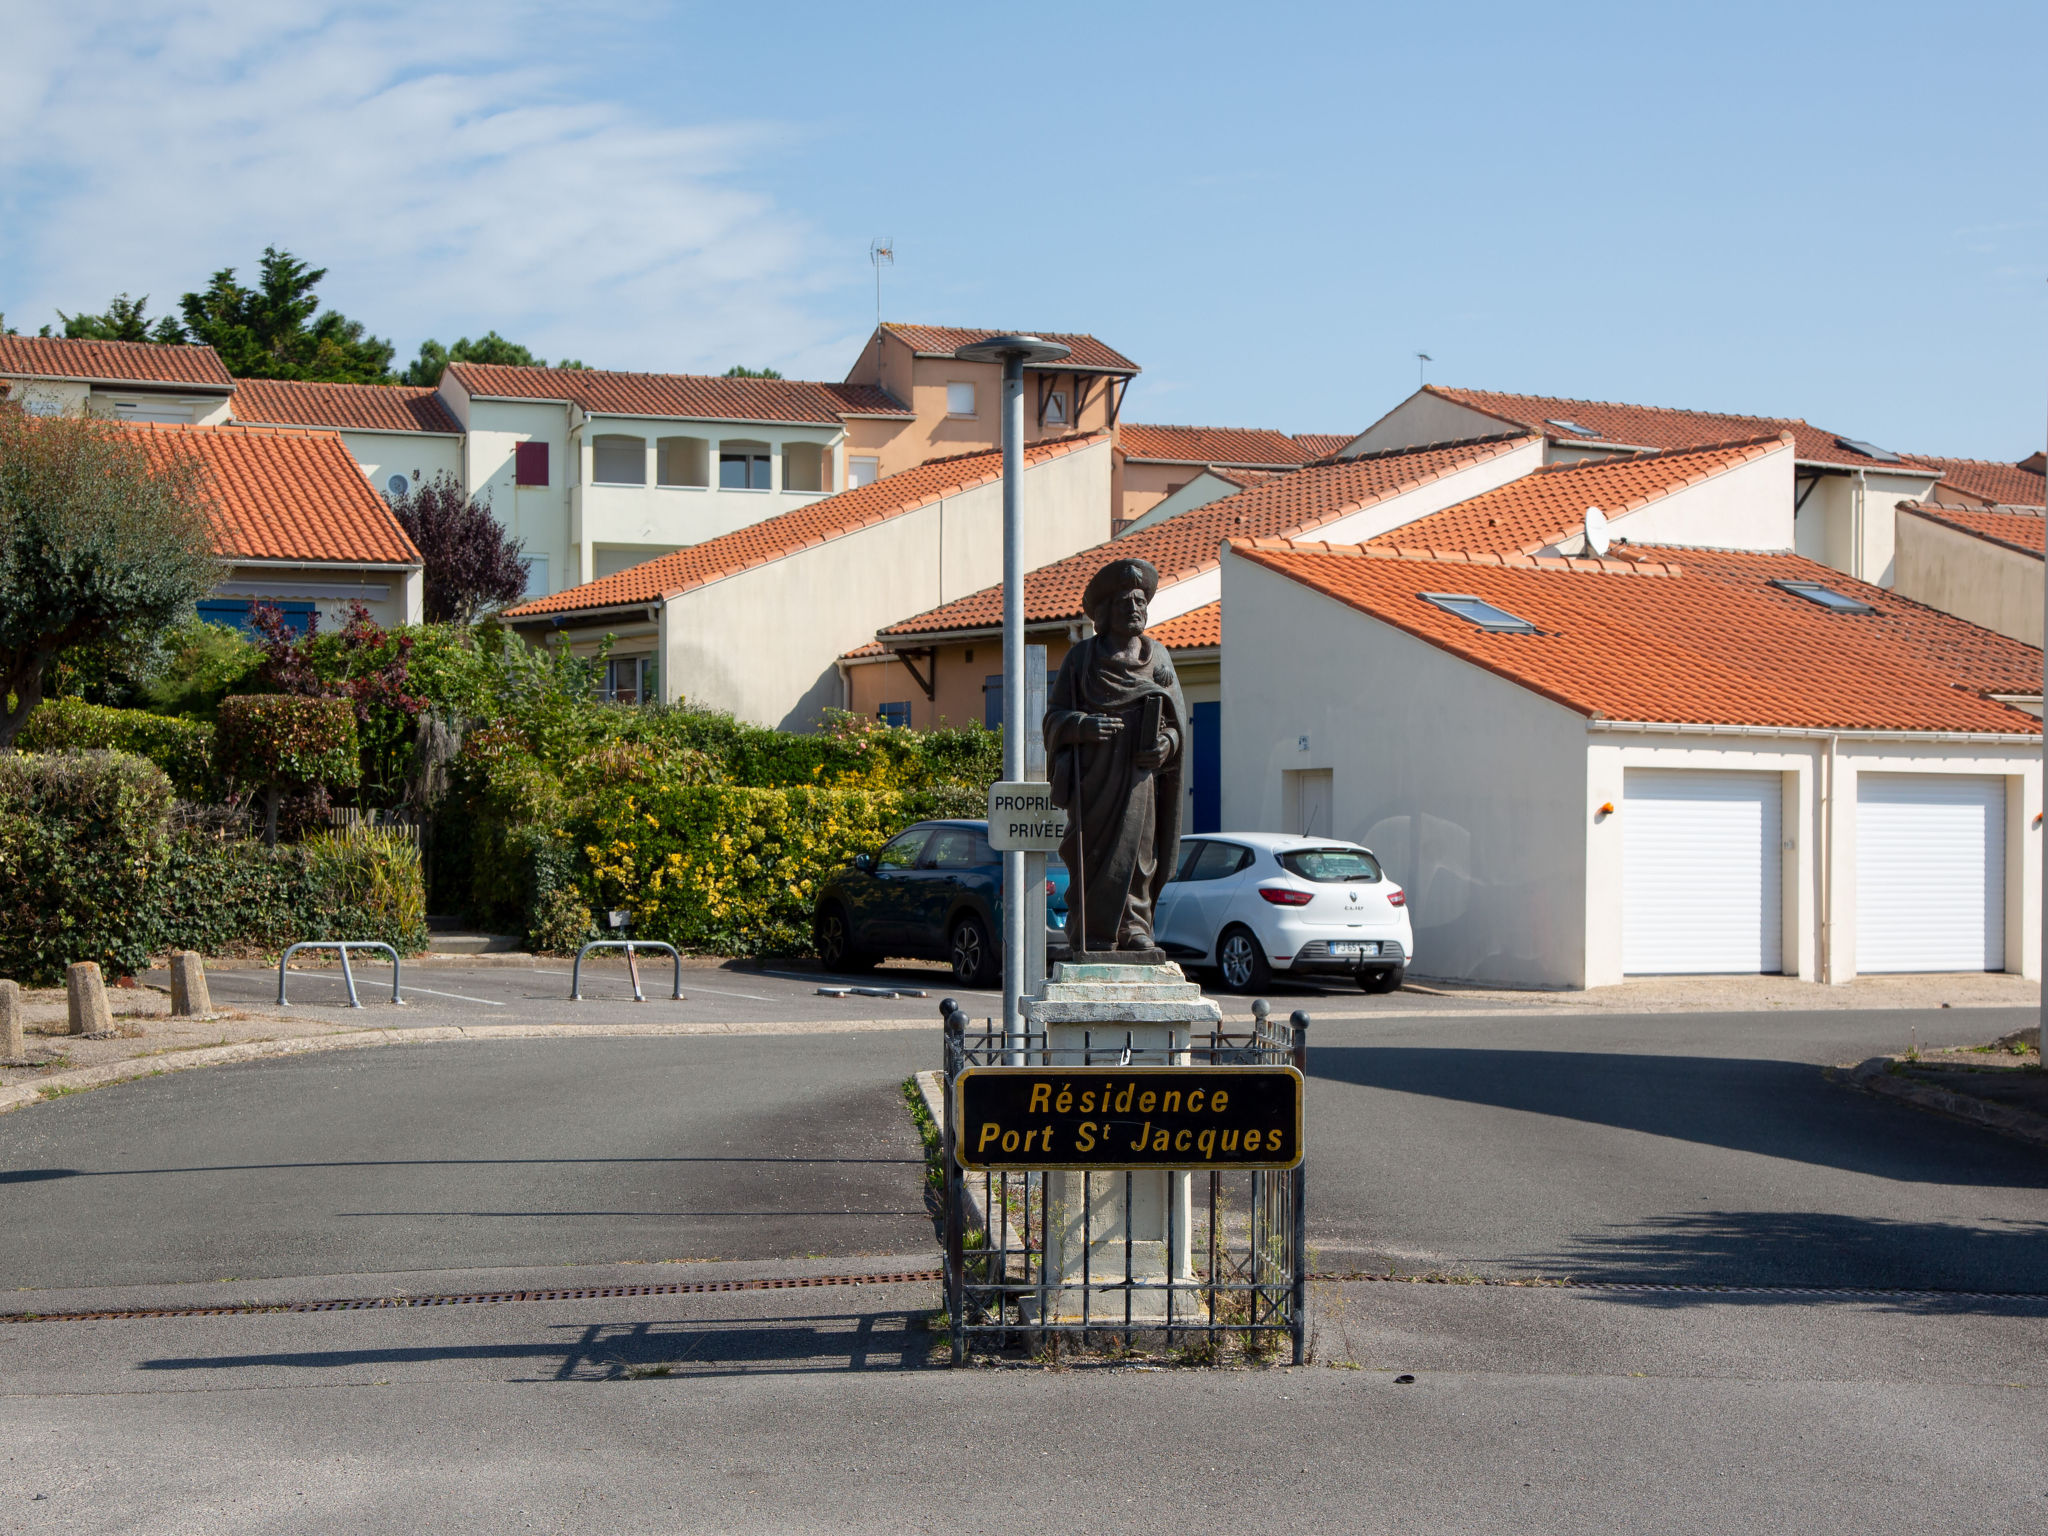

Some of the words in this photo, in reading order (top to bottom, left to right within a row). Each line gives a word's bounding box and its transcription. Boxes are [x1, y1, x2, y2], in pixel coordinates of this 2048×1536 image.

[995, 796, 1065, 811] PROPRI
[1009, 820, 1065, 838] PRIVÉE
[1029, 1082, 1229, 1113] Résidence
[978, 1122, 1054, 1152] Port
[1075, 1121, 1111, 1152] St
[1130, 1121, 1283, 1159] Jacques
